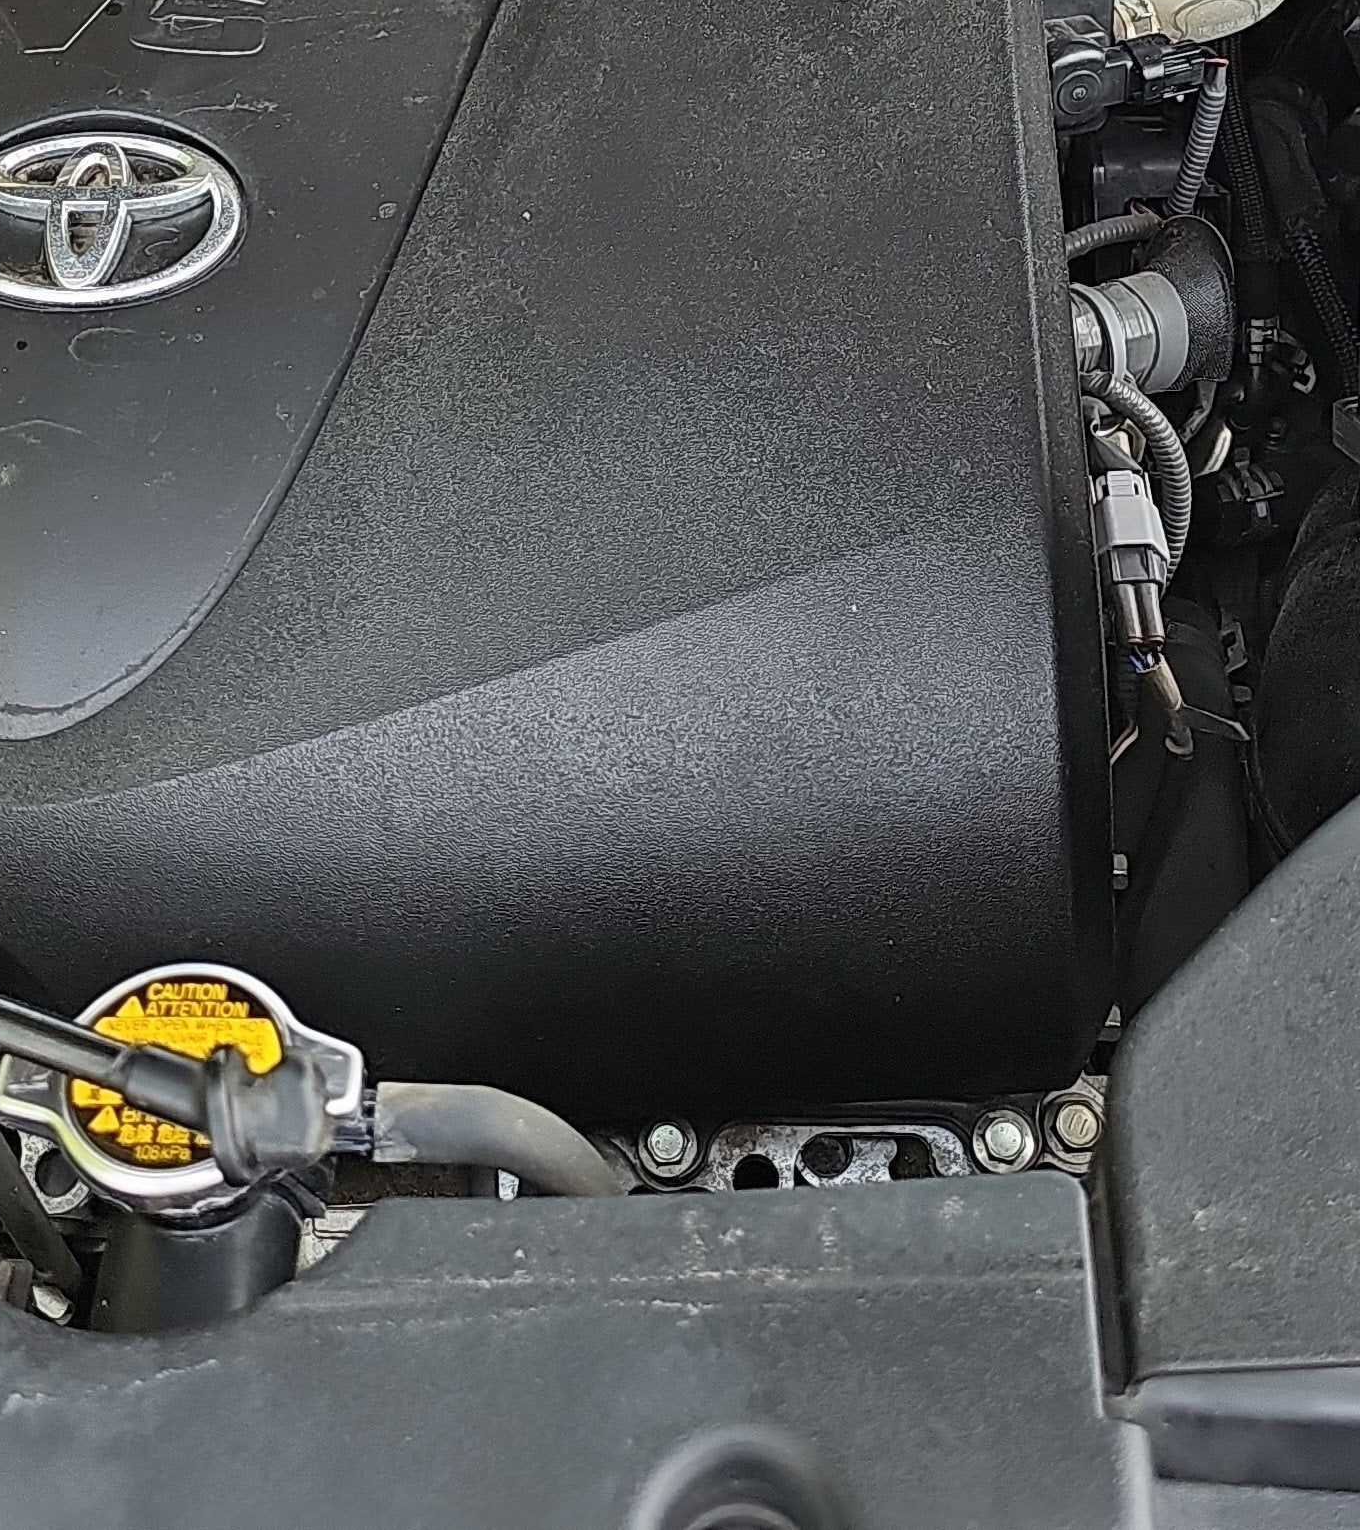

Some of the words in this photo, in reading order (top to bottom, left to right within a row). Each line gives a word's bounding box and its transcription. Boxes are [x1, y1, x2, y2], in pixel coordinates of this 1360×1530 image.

[146, 983, 228, 1001] CAUTION
[145, 1001, 250, 1018] ATTENTION
[108, 1020, 149, 1031] NEVER
[155, 1020, 189, 1031] OPEN
[196, 1020, 233, 1031] WHEN
[240, 1020, 268, 1032] HOT
